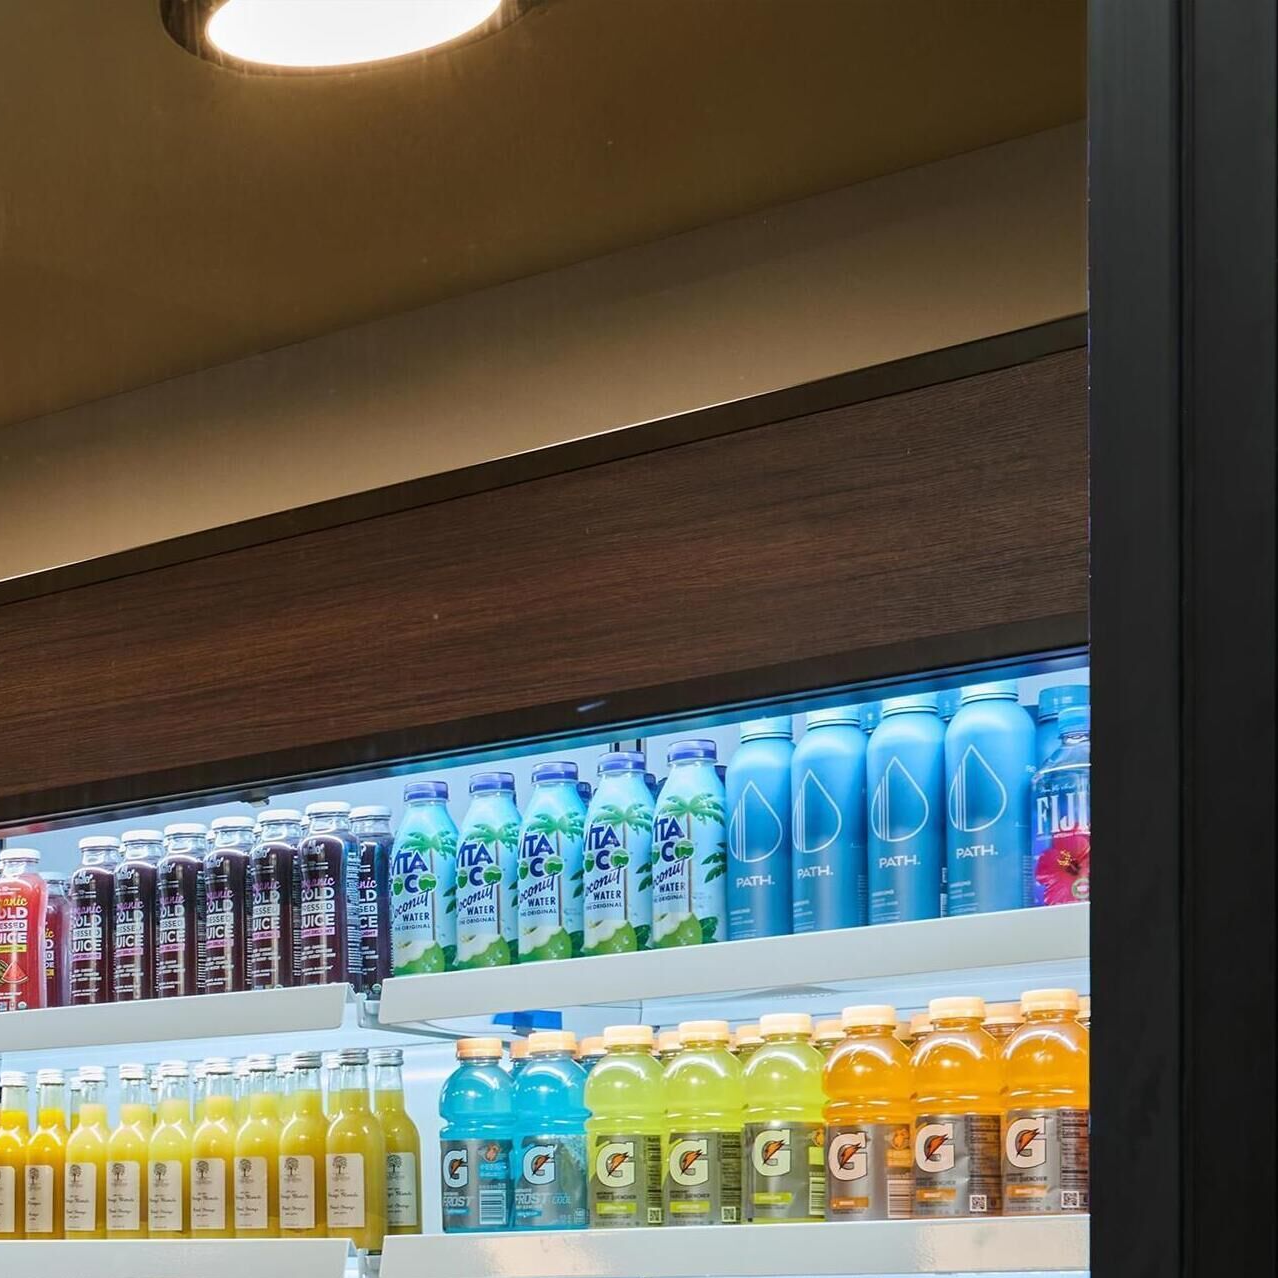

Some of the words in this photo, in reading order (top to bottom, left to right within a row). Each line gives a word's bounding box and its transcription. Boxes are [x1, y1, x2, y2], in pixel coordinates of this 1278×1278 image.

[528, 897, 556, 907] WATER
[594, 890, 621, 900] WATER
[659, 882, 685, 892] WATER
[403, 912, 430, 921] WATER
[467, 905, 494, 916] WATER
[669, 1139, 710, 1186] G
[752, 1129, 791, 1176] G
[828, 1131, 868, 1181] G
[915, 1123, 955, 1173] G
[1006, 1117, 1047, 1169] G
[444, 1150, 468, 1188] G
[523, 1144, 556, 1185] G
[596, 1141, 636, 1188] G
